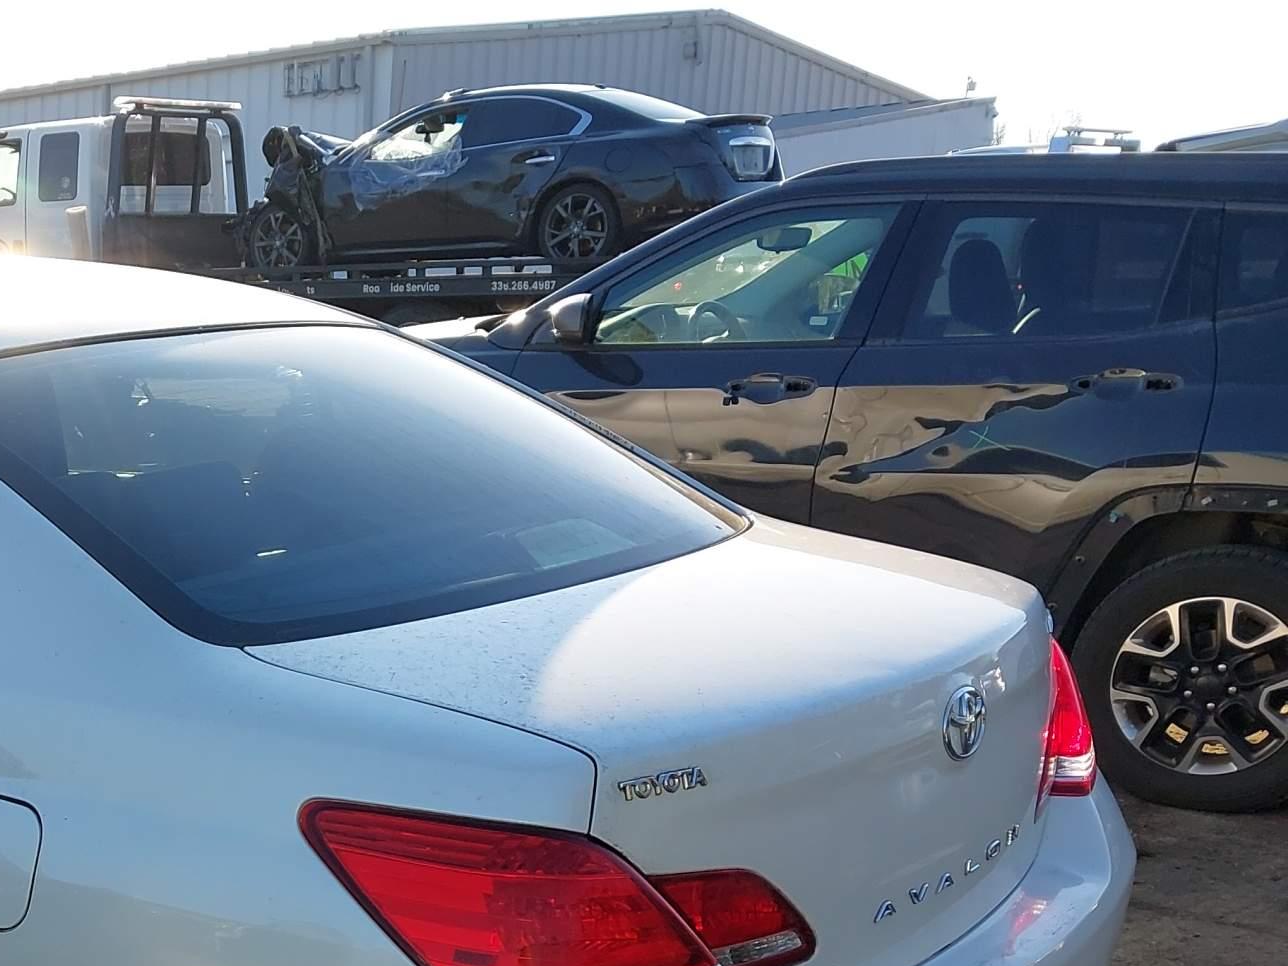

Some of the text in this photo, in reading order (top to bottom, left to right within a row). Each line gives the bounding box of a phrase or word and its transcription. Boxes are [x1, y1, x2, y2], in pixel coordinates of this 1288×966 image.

[362, 282, 404, 293] Roaide
[405, 281, 440, 293] Service
[618, 766, 708, 801] TOYOTA
[873, 824, 1020, 923] AVALON
